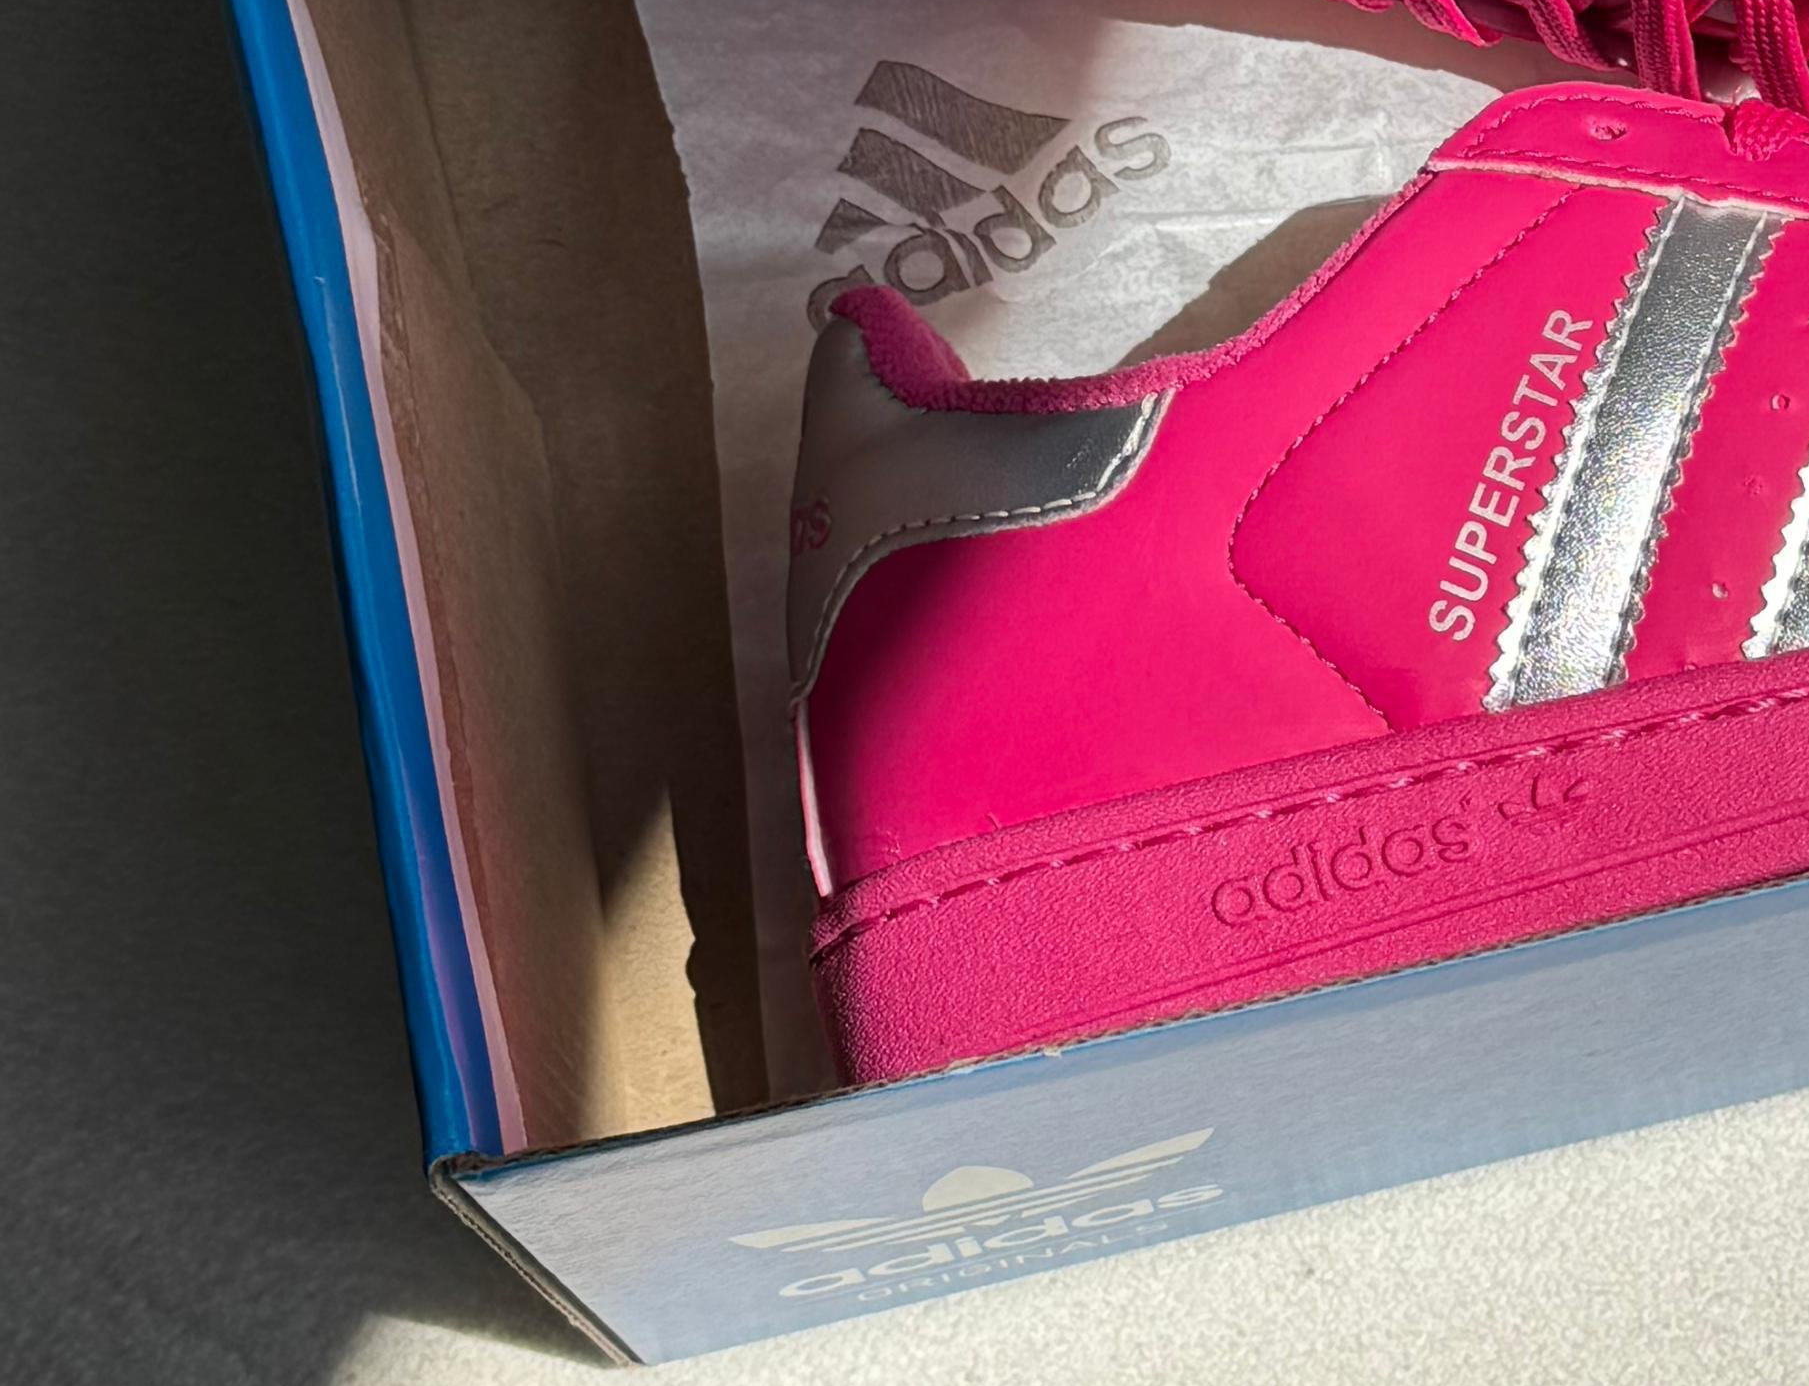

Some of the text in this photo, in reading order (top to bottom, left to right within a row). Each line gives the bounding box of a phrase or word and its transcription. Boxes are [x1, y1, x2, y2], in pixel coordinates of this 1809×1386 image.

[1428, 309, 1594, 642] SUPERSTAR
[1211, 816, 1472, 928] adidas
[777, 1183, 1225, 1298] adidas
[857, 1221, 1169, 1303] ORIGINALS
